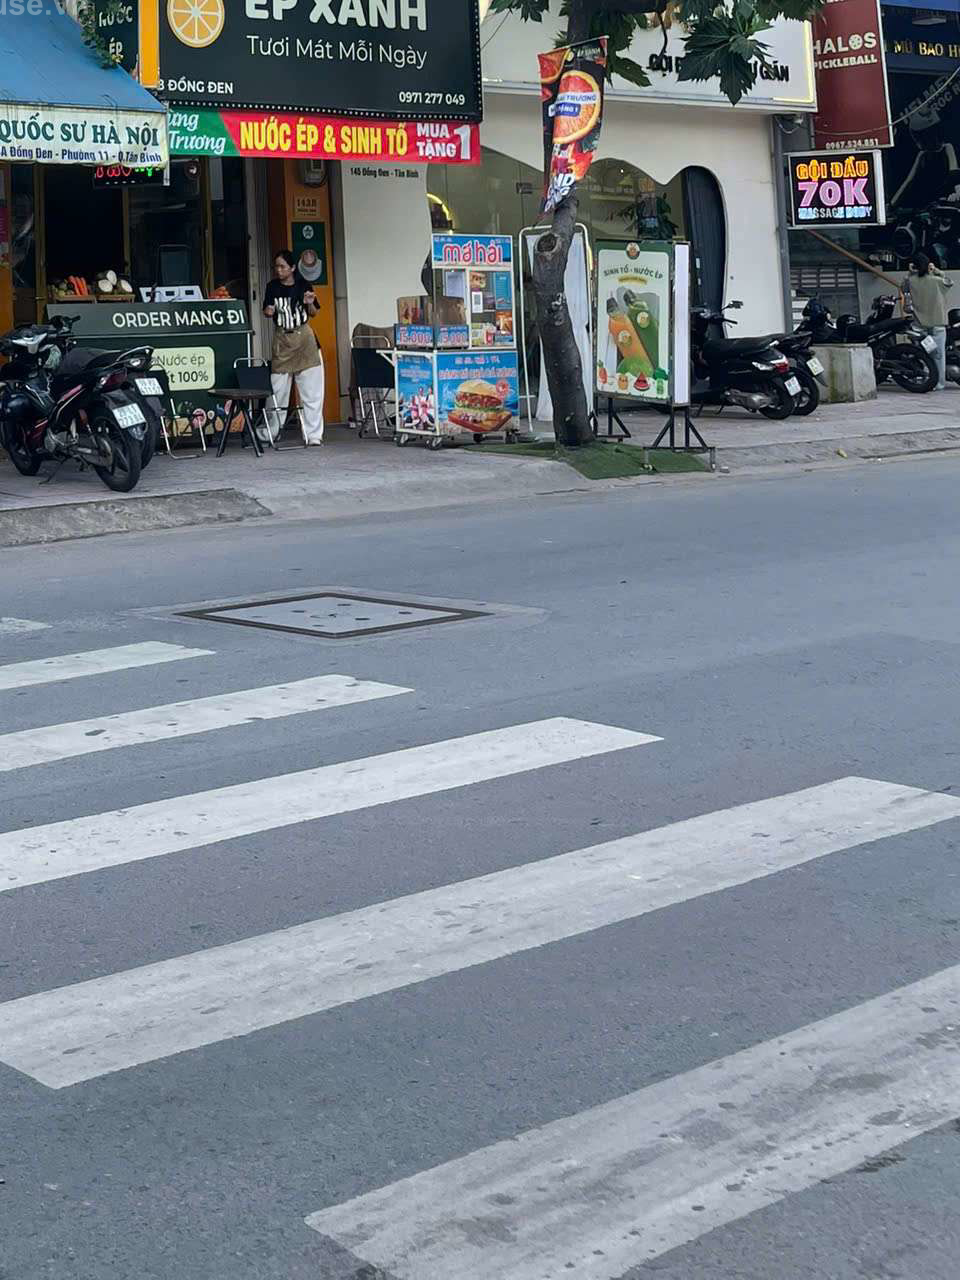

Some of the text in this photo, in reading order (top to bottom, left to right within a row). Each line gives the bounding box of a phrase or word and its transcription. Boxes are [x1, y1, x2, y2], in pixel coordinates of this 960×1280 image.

[246, 34, 428, 70] Tươi Mát Mỗi Ngày
[168, 76, 205, 93] ĐỒNG
[207, 81, 234, 95] ĐEN
[399, 91, 466, 106] 0971 277 049
[60, 120, 87, 143] SƯ
[92, 121, 121, 144] HÀ
[126, 123, 159, 151] NỘI
[241, 116, 291, 152] NƯỚC
[296, 118, 319, 153] ÉP
[324, 124, 337, 153] &
[340, 125, 382, 155] SINH
[416, 122, 450, 138] MUA
[416, 125, 471, 160] TẶNG 1
[796, 160, 828, 181] GỘI
[798, 178, 870, 207] 70K
[112, 309, 245, 328] ORDER MANG ĐI
[177, 370, 209, 384] 100%
